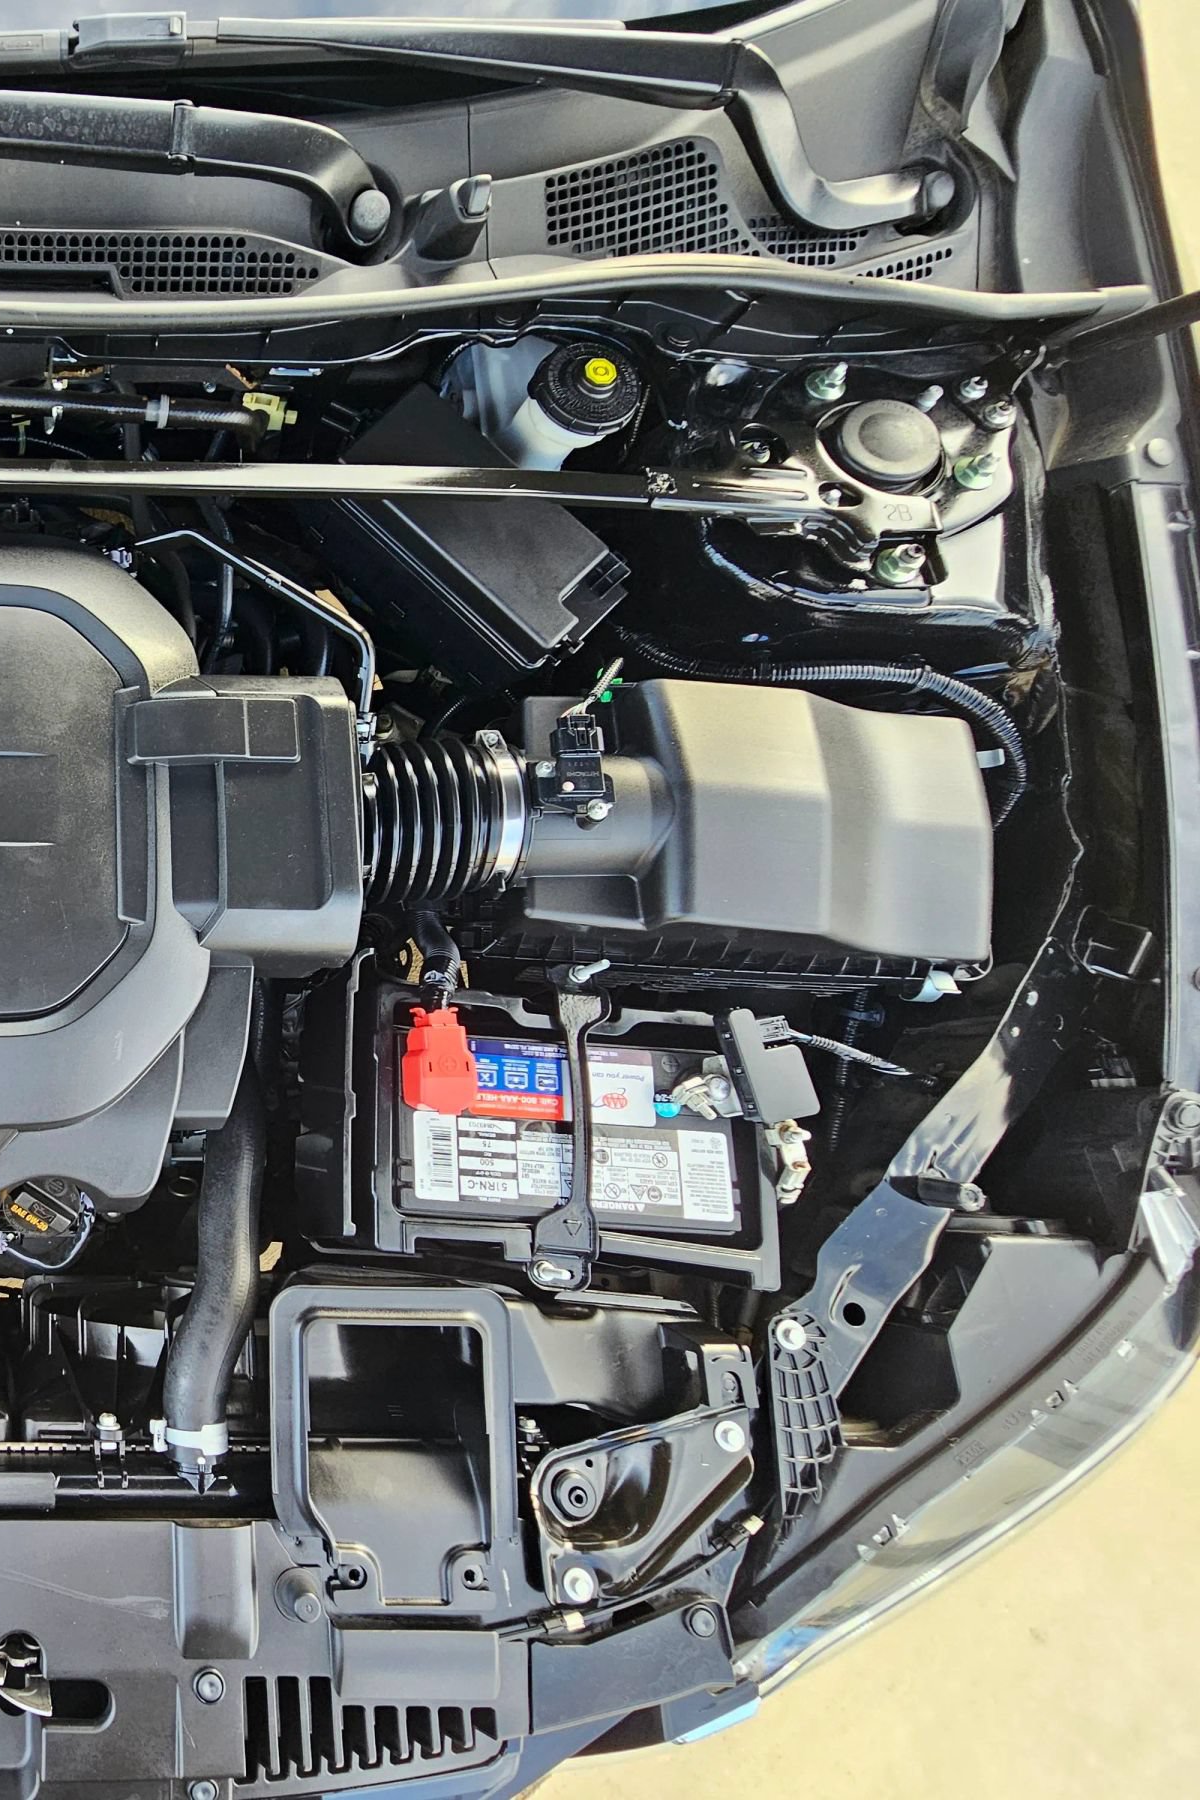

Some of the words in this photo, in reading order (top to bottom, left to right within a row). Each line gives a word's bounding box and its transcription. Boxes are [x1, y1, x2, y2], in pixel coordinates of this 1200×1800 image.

[883, 503, 913, 521] 2B
[621, 1073, 645, 1082] Power
[481, 1140, 492, 1148] 75
[479, 1158, 495, 1167] 500
[467, 1179, 508, 1192] 51RN-C
[10, 1203, 28, 1219] SAE
[26, 1213, 49, 1232] 0W-20
